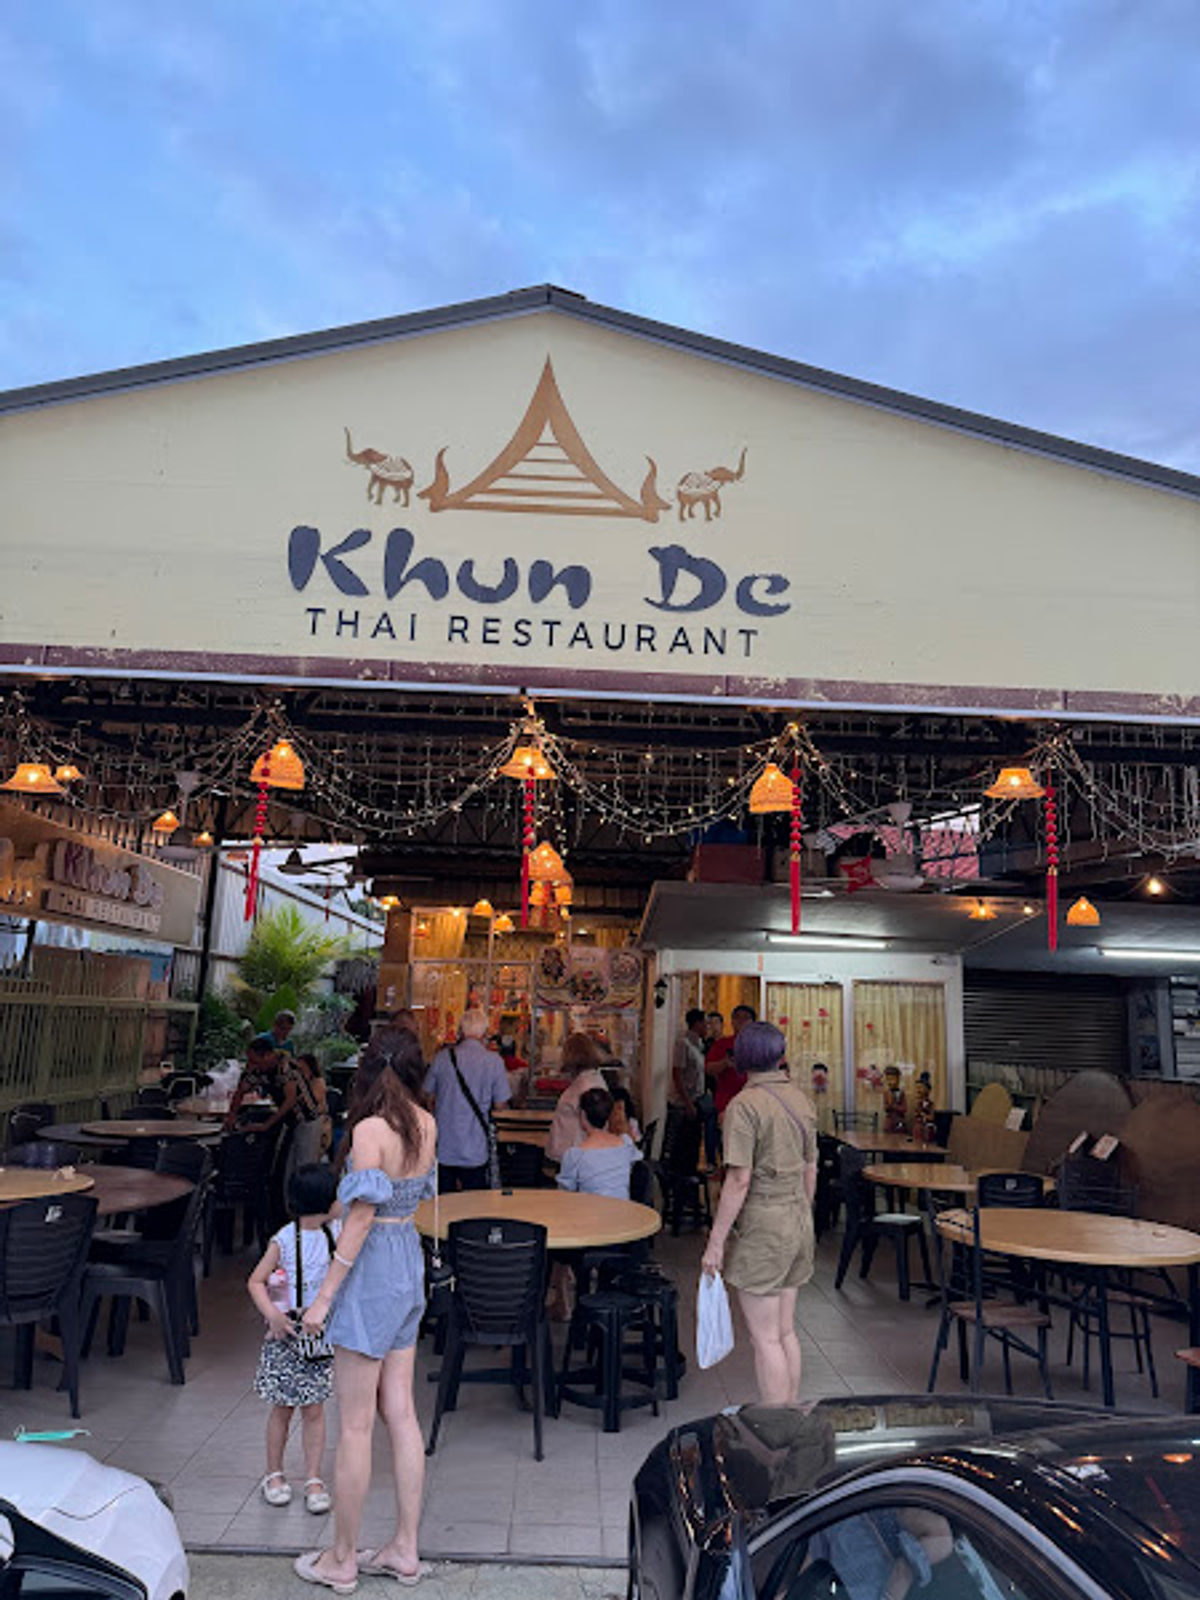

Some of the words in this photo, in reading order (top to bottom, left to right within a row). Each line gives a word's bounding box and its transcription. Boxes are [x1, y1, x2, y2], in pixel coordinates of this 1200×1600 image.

[287, 525, 592, 610] Khun
[306, 607, 417, 642] THAI
[448, 614, 758, 657] RESTAURANT
